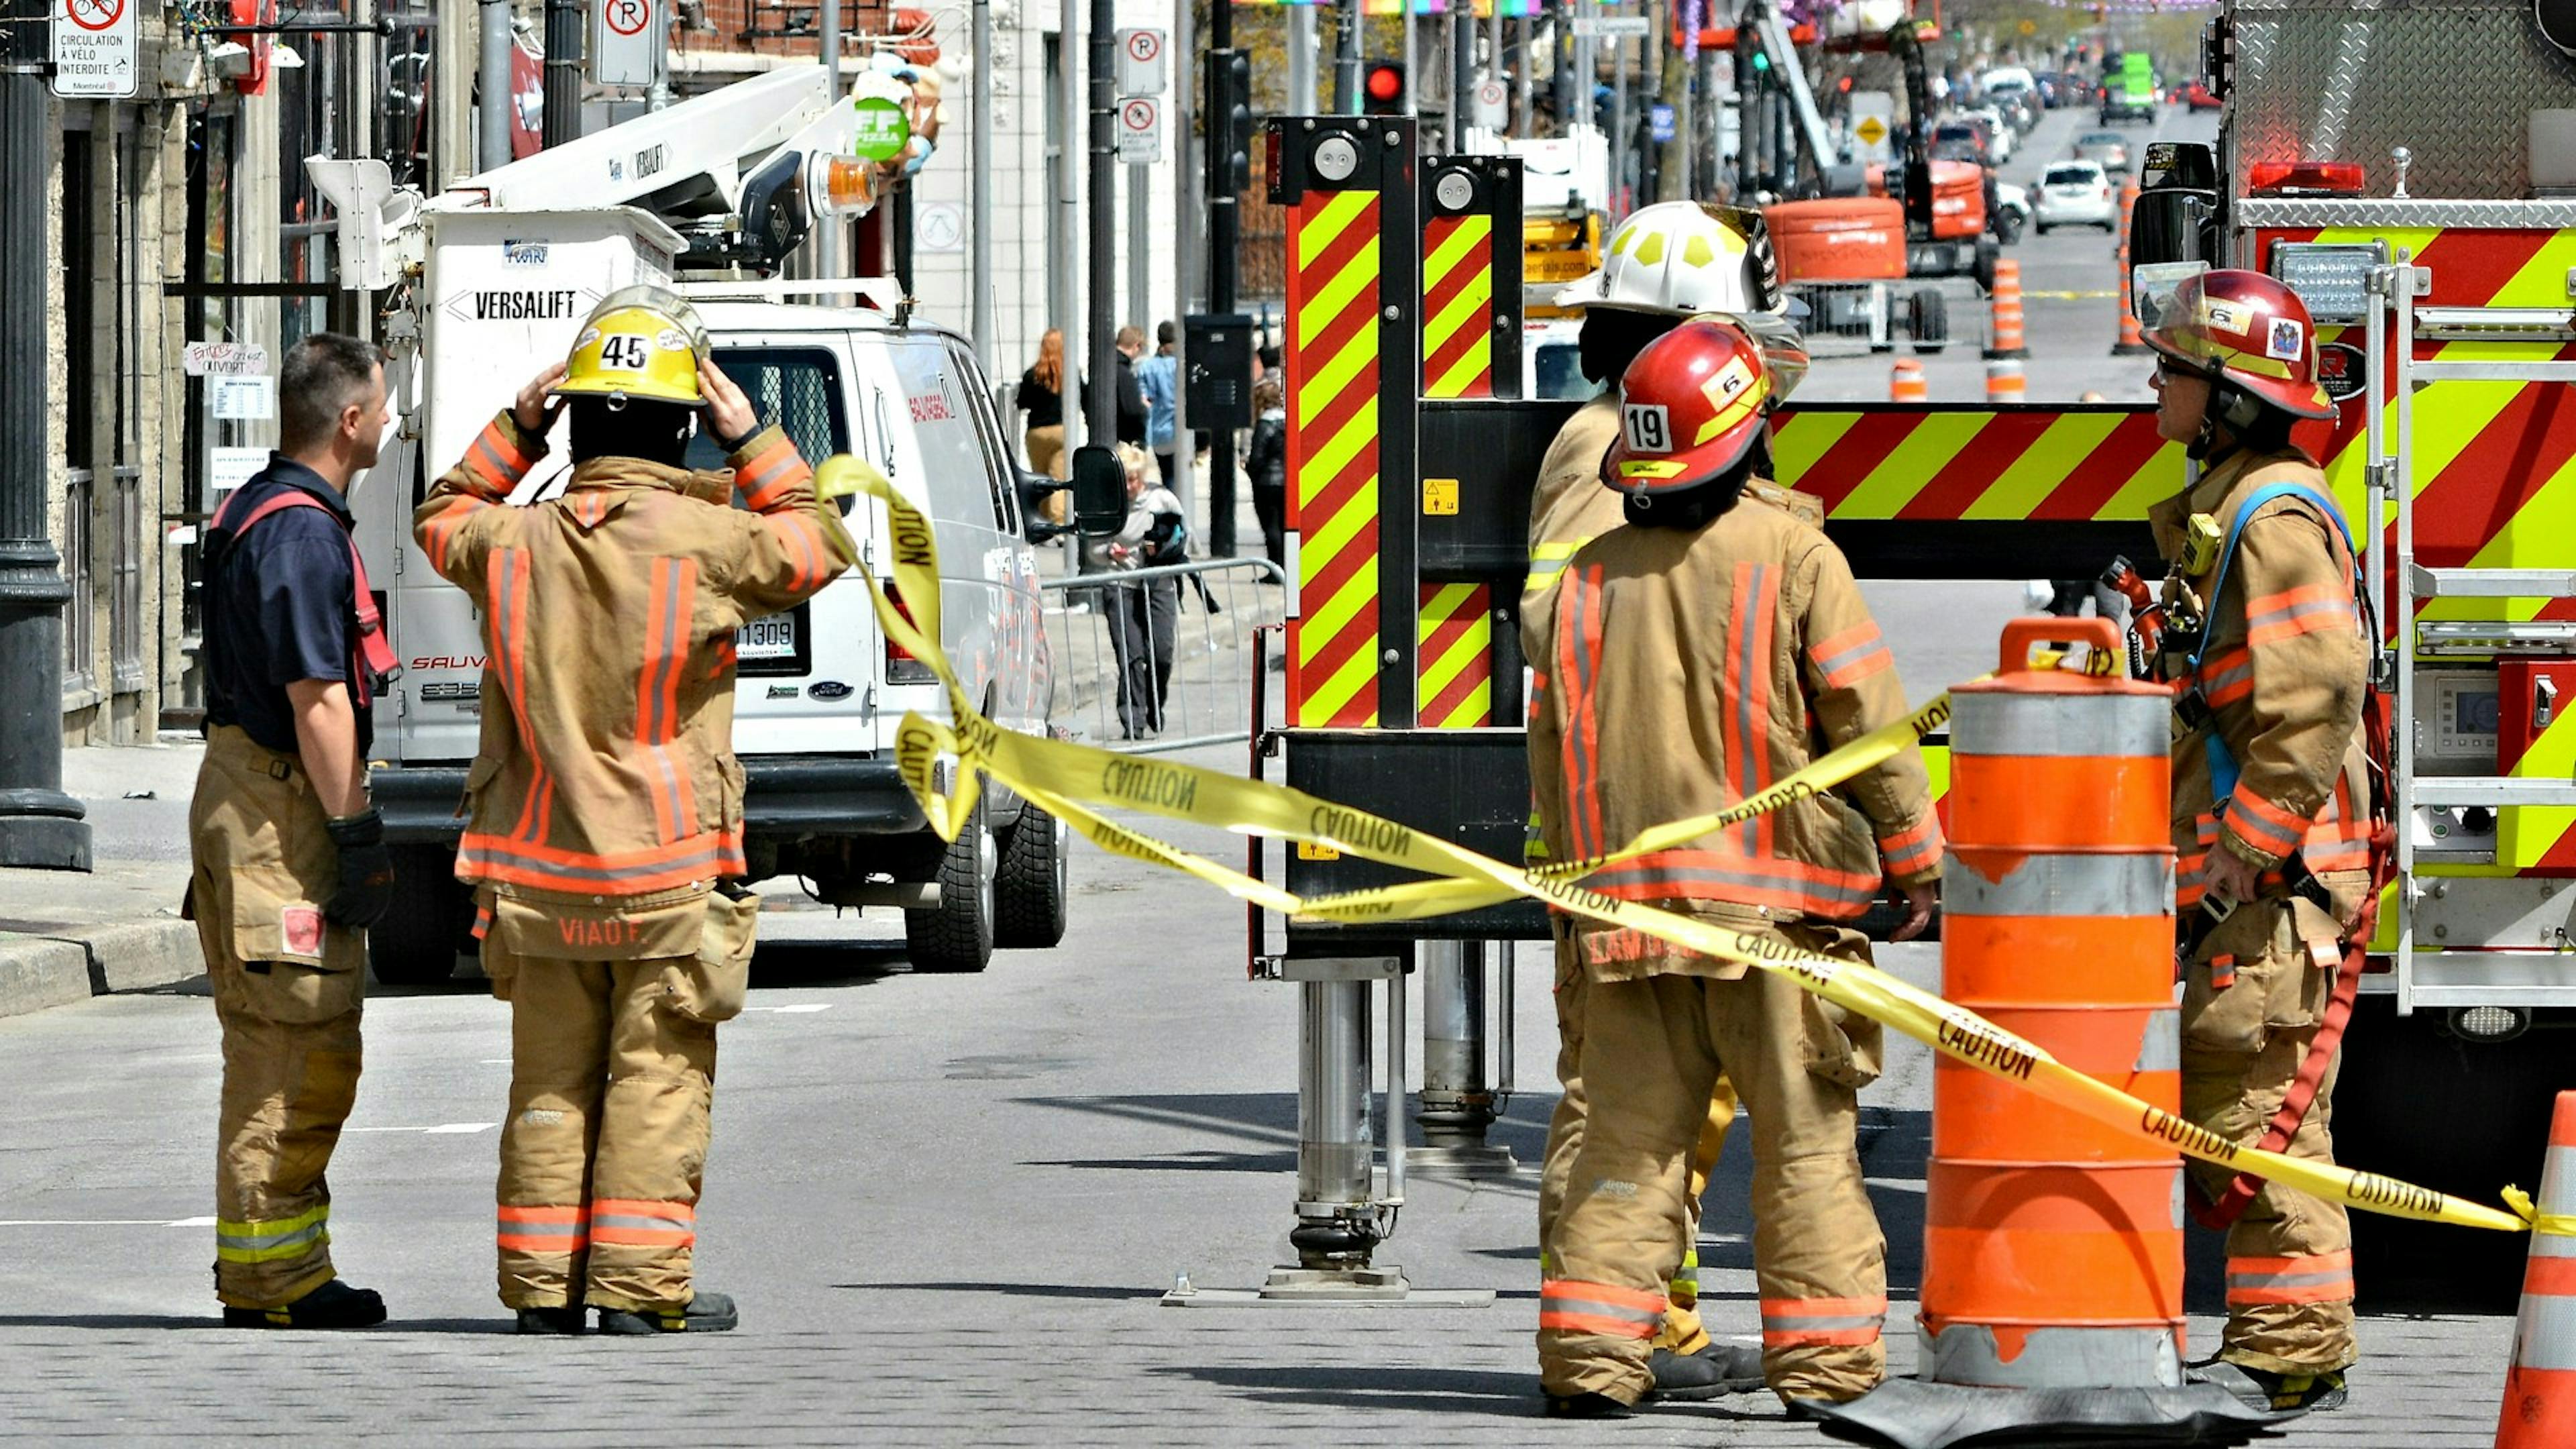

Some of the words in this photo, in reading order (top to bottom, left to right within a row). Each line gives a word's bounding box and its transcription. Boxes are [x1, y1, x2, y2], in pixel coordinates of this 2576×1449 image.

[60, 35, 123, 46] CIRCULATION
[61, 46, 68, 60] À
[71, 46, 96, 60] VÉLO
[60, 64, 109, 74] INTERDITE
[476, 290, 576, 319] VERSALIFT
[602, 336, 648, 368] 45
[1723, 374, 1741, 394] 6
[1629, 409, 1664, 448] 19
[736, 623, 792, 646] 1309
[411, 655, 486, 669] SAUV
[558, 916, 622, 945] VIAU
[1938, 1018, 2037, 1081] CAUTION
[2142, 1106, 2238, 1161] CAUTION
[2347, 1171, 2443, 1214] CAUTION
